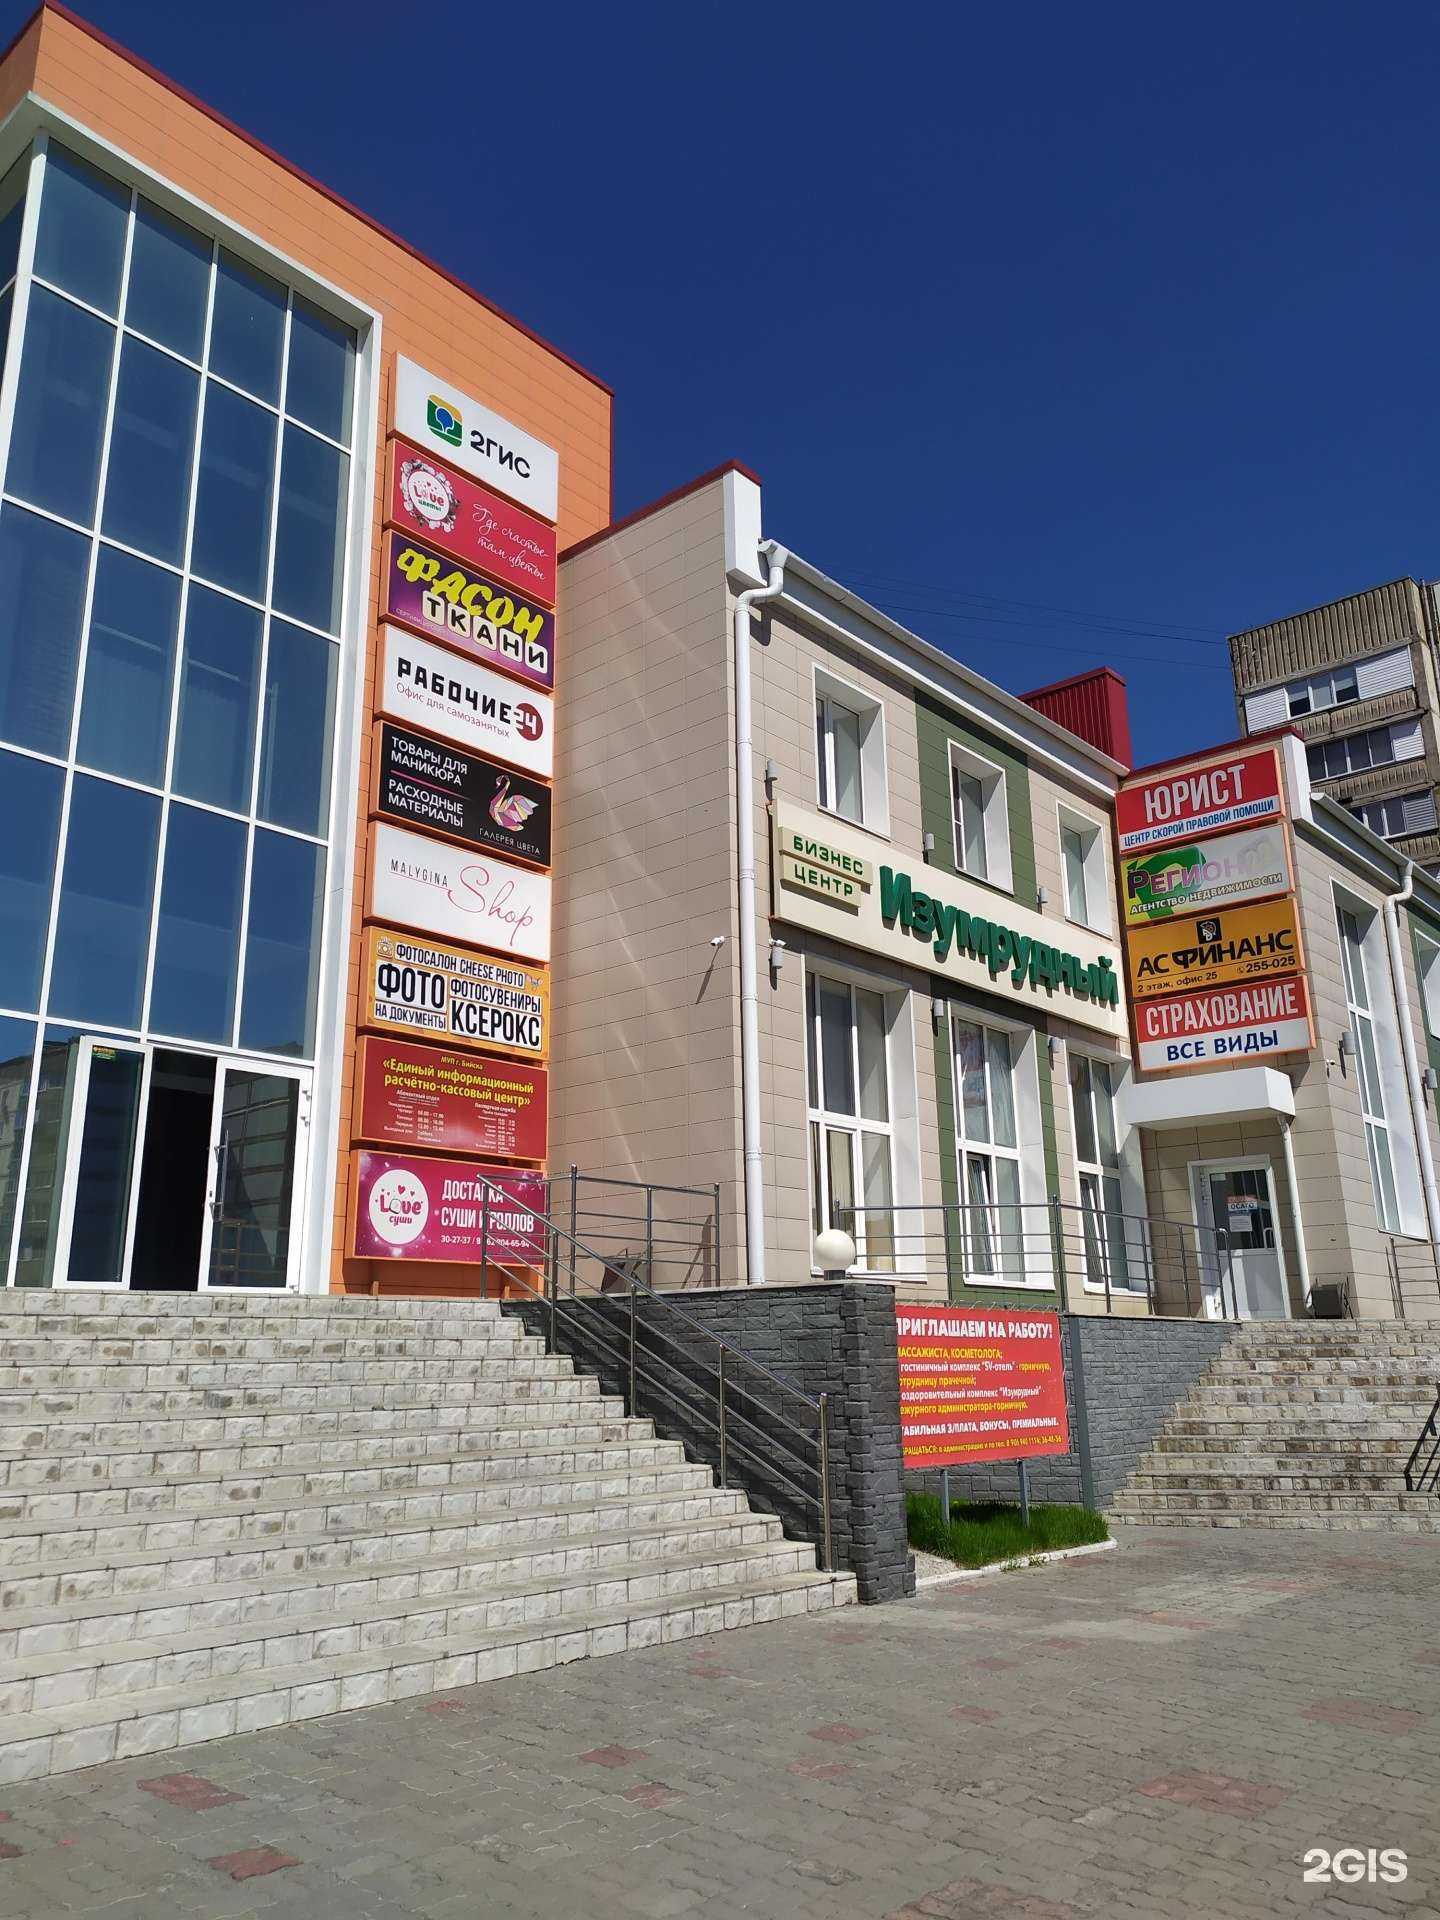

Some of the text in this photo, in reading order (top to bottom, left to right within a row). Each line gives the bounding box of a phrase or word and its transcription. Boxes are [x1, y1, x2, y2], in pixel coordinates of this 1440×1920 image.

[470, 430, 530, 479] 2ГИС
[508, 550, 546, 580] цветы
[396, 548, 544, 642] ФАСОН
[425, 597, 545, 669] ТКАНИ
[396, 683, 510, 738] Офис для самозанятых
[391, 736, 468, 775] ТОВАРЫ ДЛЯ
[391, 750, 462, 786] МАНИКЮРА
[388, 792, 463, 828] МАТЕРИАЛЫ
[389, 779, 464, 815] РАСХОДНЫЕ
[1144, 764, 1245, 823] ЮРИСТ
[479, 827, 541, 855] ГАЛЕРЕЯ ЦВЕТА
[1124, 799, 1275, 847] ЦЕНТР СКОРОЙ ПРАВОВОЙ ПОМОЩИ
[391, 858, 448, 887] MALYGINA
[793, 835, 864, 876] БИЗНЕС
[794, 864, 853, 897] ЦЕНТР
[1130, 873, 1283, 915] АГЕНТСТВО НЕДВИЖИМОСТИ
[448, 865, 534, 946] Shop
[879, 865, 1120, 1006] Изумрудный
[396, 944, 524, 987] ФОТОСАЛОН CHEESE PHOTO
[1138, 956, 1296, 993] 2 этаж, офис 25 255-025
[378, 963, 445, 1009] ФОТО
[451, 978, 541, 1014] ФОТОСУВЕНИРЫ
[375, 1002, 446, 1030] НА ДОКУМЕНТЫ
[451, 1000, 540, 1047] КСЕРОКС
[1146, 983, 1298, 1037] СТРАХОВАНИЕ
[441, 1055, 455, 1065] МУП
[461, 1060, 483, 1070] Бийска
[1167, 1029, 1278, 1062] ВСЕ ВИДЫ
[383, 1058, 534, 1094] «Единый информационный
[384, 1074, 531, 1107] расчётно-кассовый центр»
[379, 1193, 423, 1215] Love
[388, 1214, 412, 1226] суши
[441, 1206, 476, 1228] СУШИ
[489, 1211, 534, 1233] РОЛЛОВ
[441, 1235, 471, 1244] 30-27-37
[988, 1321, 1007, 1338] НА
[1008, 1322, 1053, 1339] РАБОТУ!
[900, 1361, 949, 1372] гостиничный
[949, 1363, 981, 1372] комплекс
[938, 1374, 977, 1388] прачечной;
[901, 1388, 966, 1402] оздоровительный
[967, 1389, 999, 1398] комплекс
[979, 1420, 1011, 1431] БОНУСЫ,
